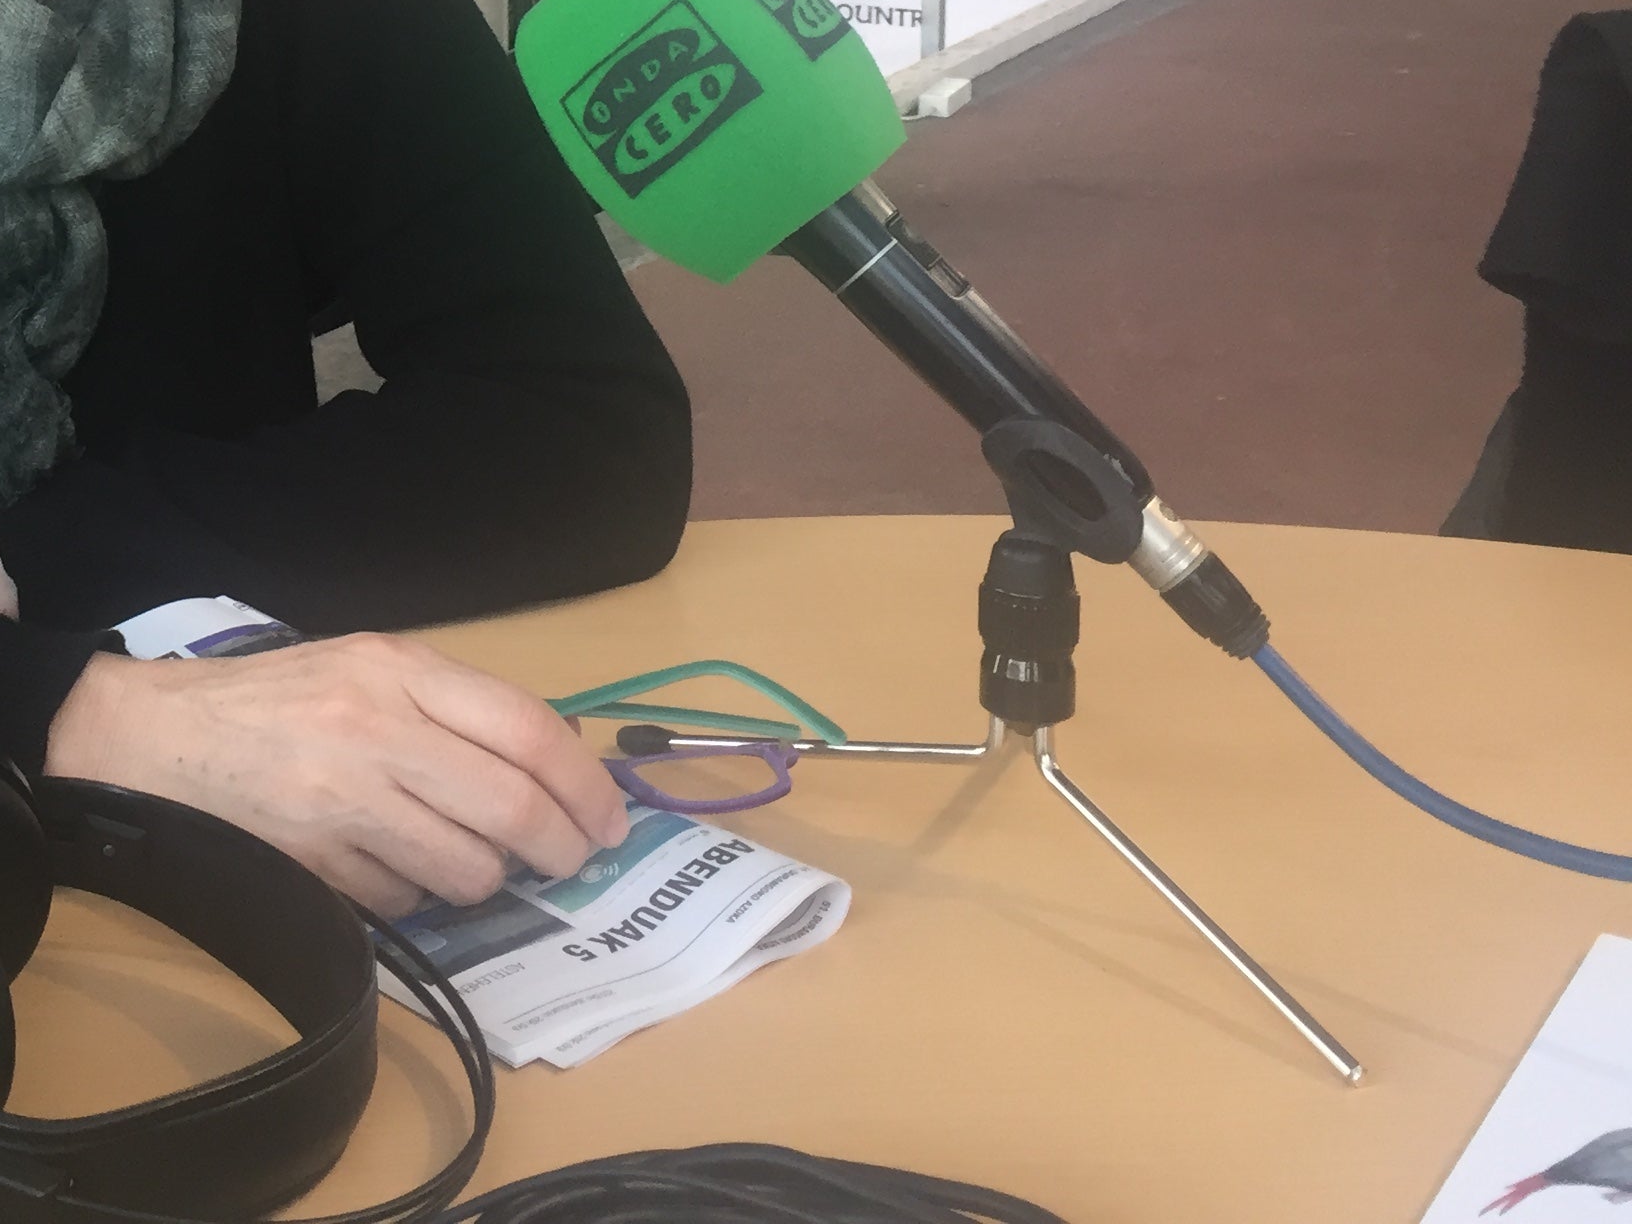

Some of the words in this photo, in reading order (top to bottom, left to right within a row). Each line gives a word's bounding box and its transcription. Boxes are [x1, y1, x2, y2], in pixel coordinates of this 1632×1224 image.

[590, 40, 689, 124] ONDA
[624, 73, 722, 161] CERO
[585, 838, 756, 954] ABENDUAK
[561, 943, 599, 962] 5
